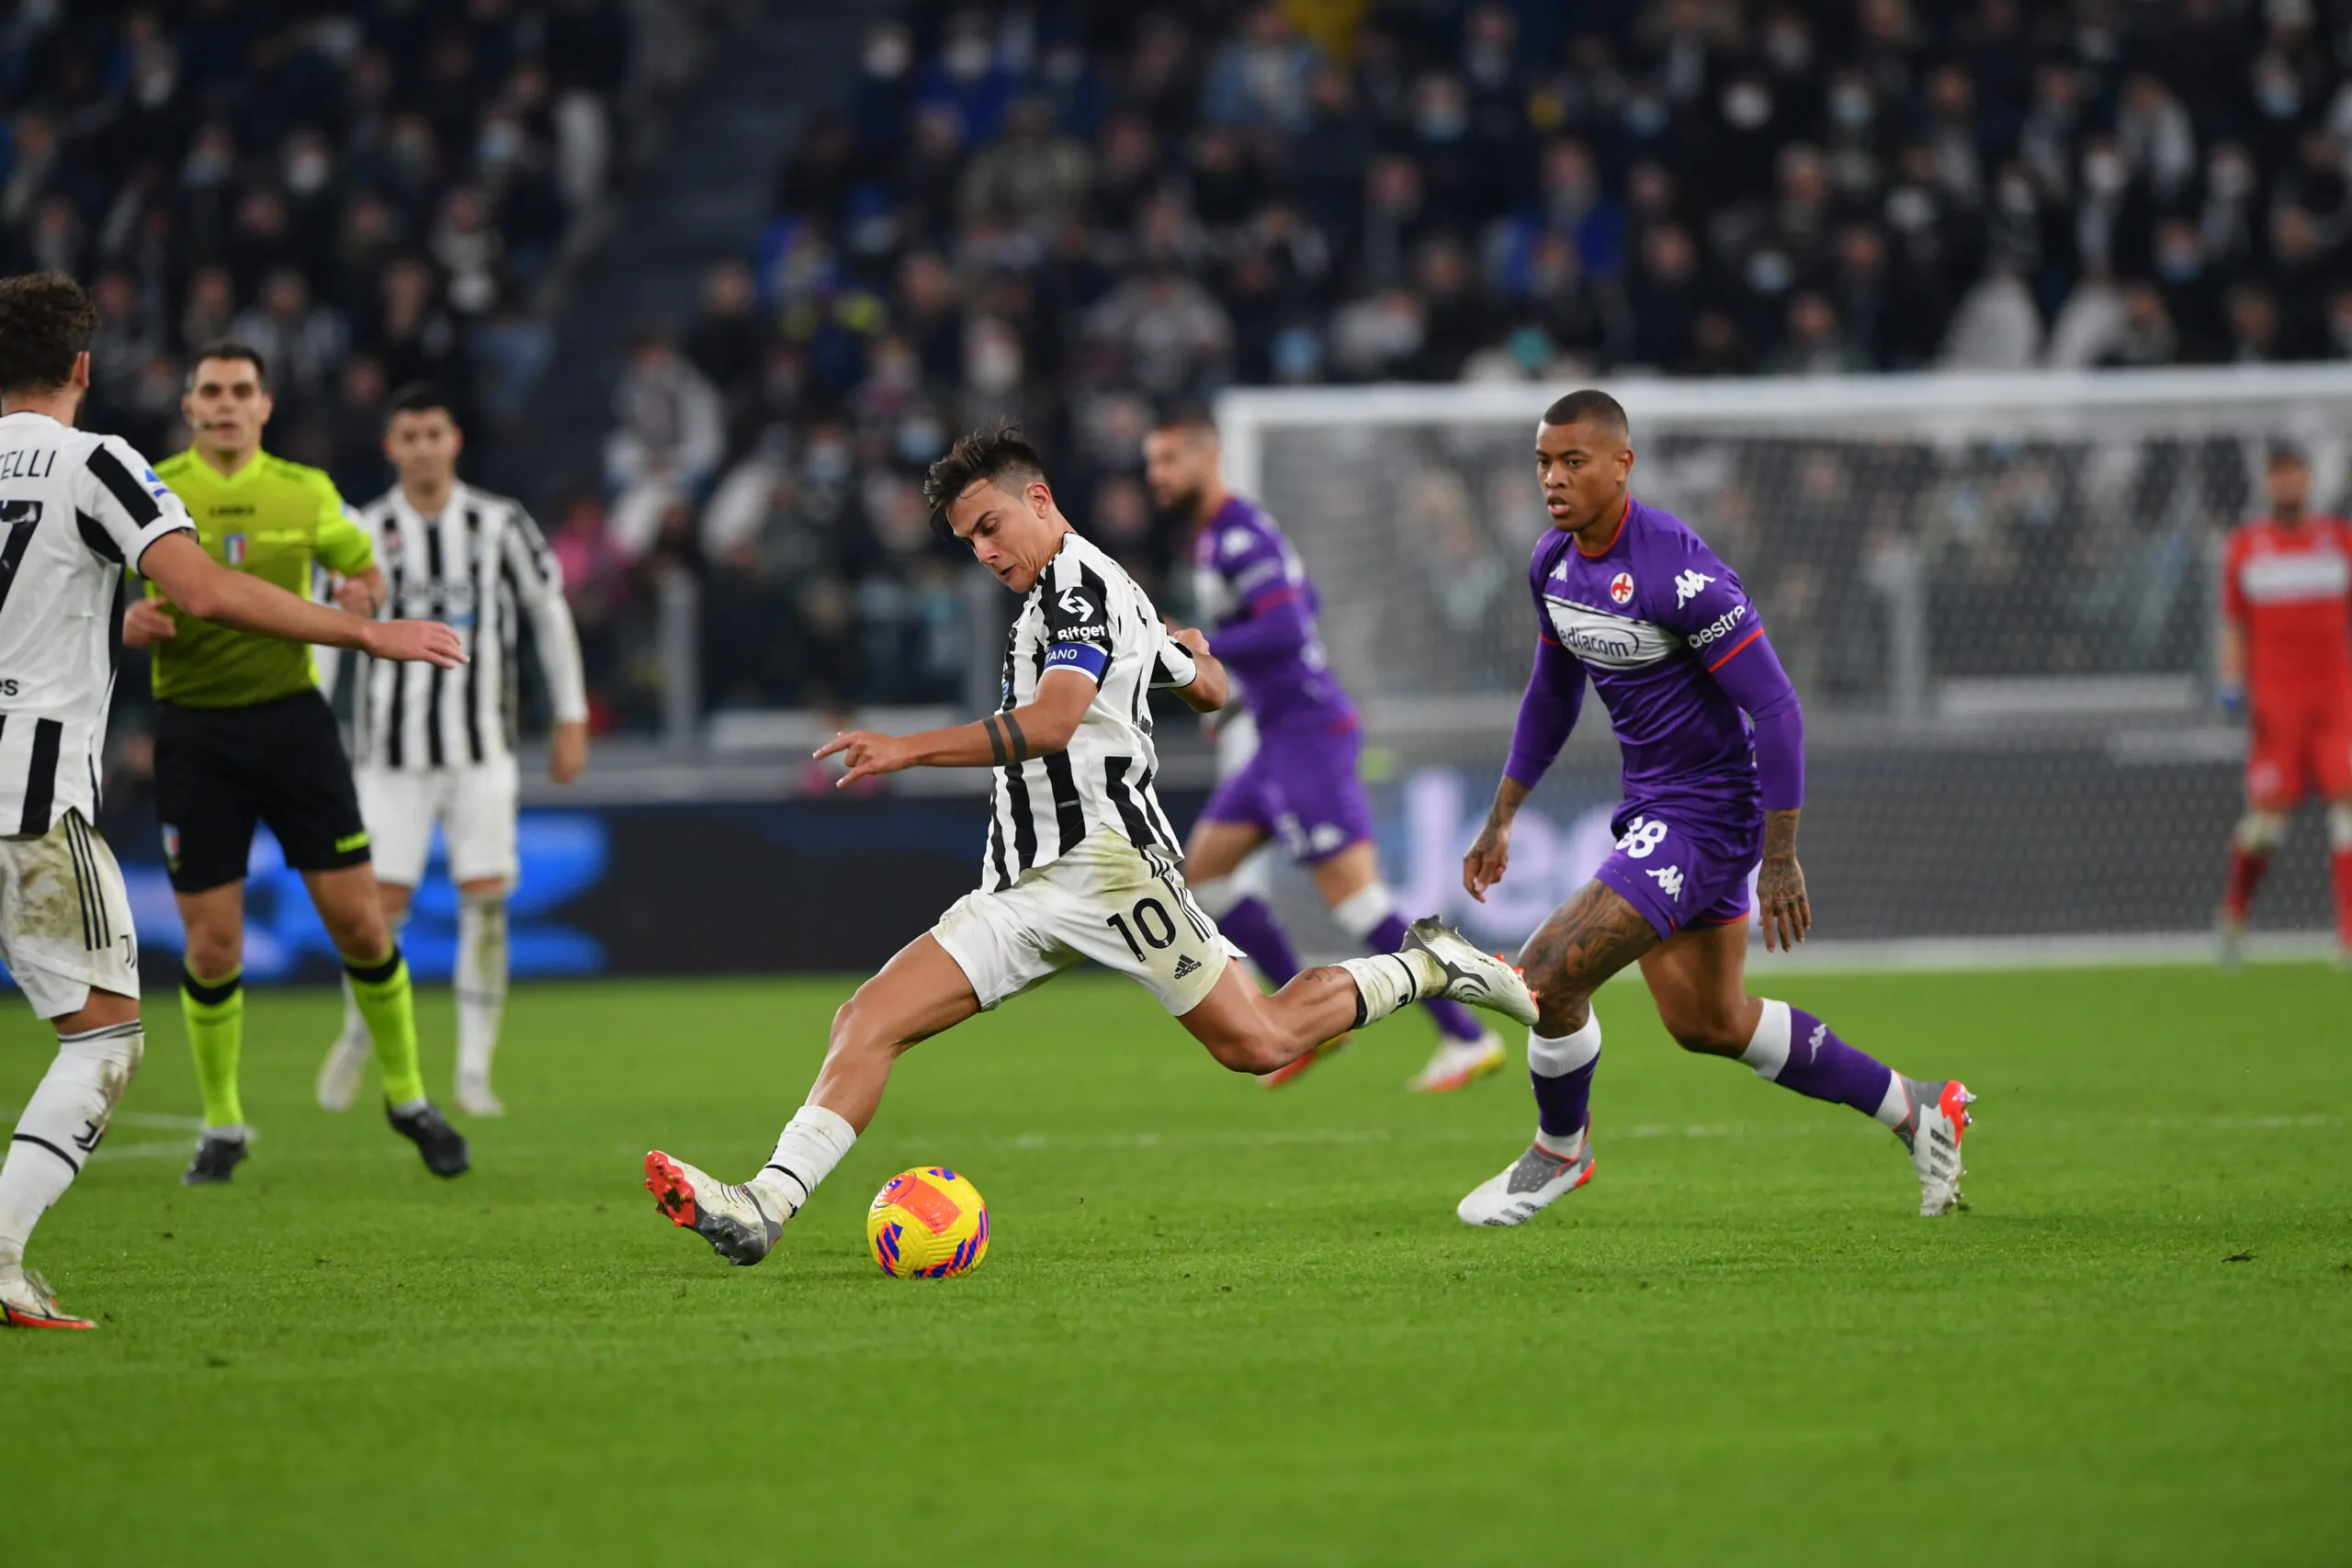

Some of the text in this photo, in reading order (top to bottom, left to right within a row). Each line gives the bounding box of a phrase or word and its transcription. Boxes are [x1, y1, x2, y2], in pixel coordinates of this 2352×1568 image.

[0, 448, 57, 479] ELLI
[1057, 624, 1106, 641] Bitget
[1554, 621, 1630, 658] ediacom
[1105, 897, 1177, 964] 10
[1174, 960, 1203, 980] adidas
